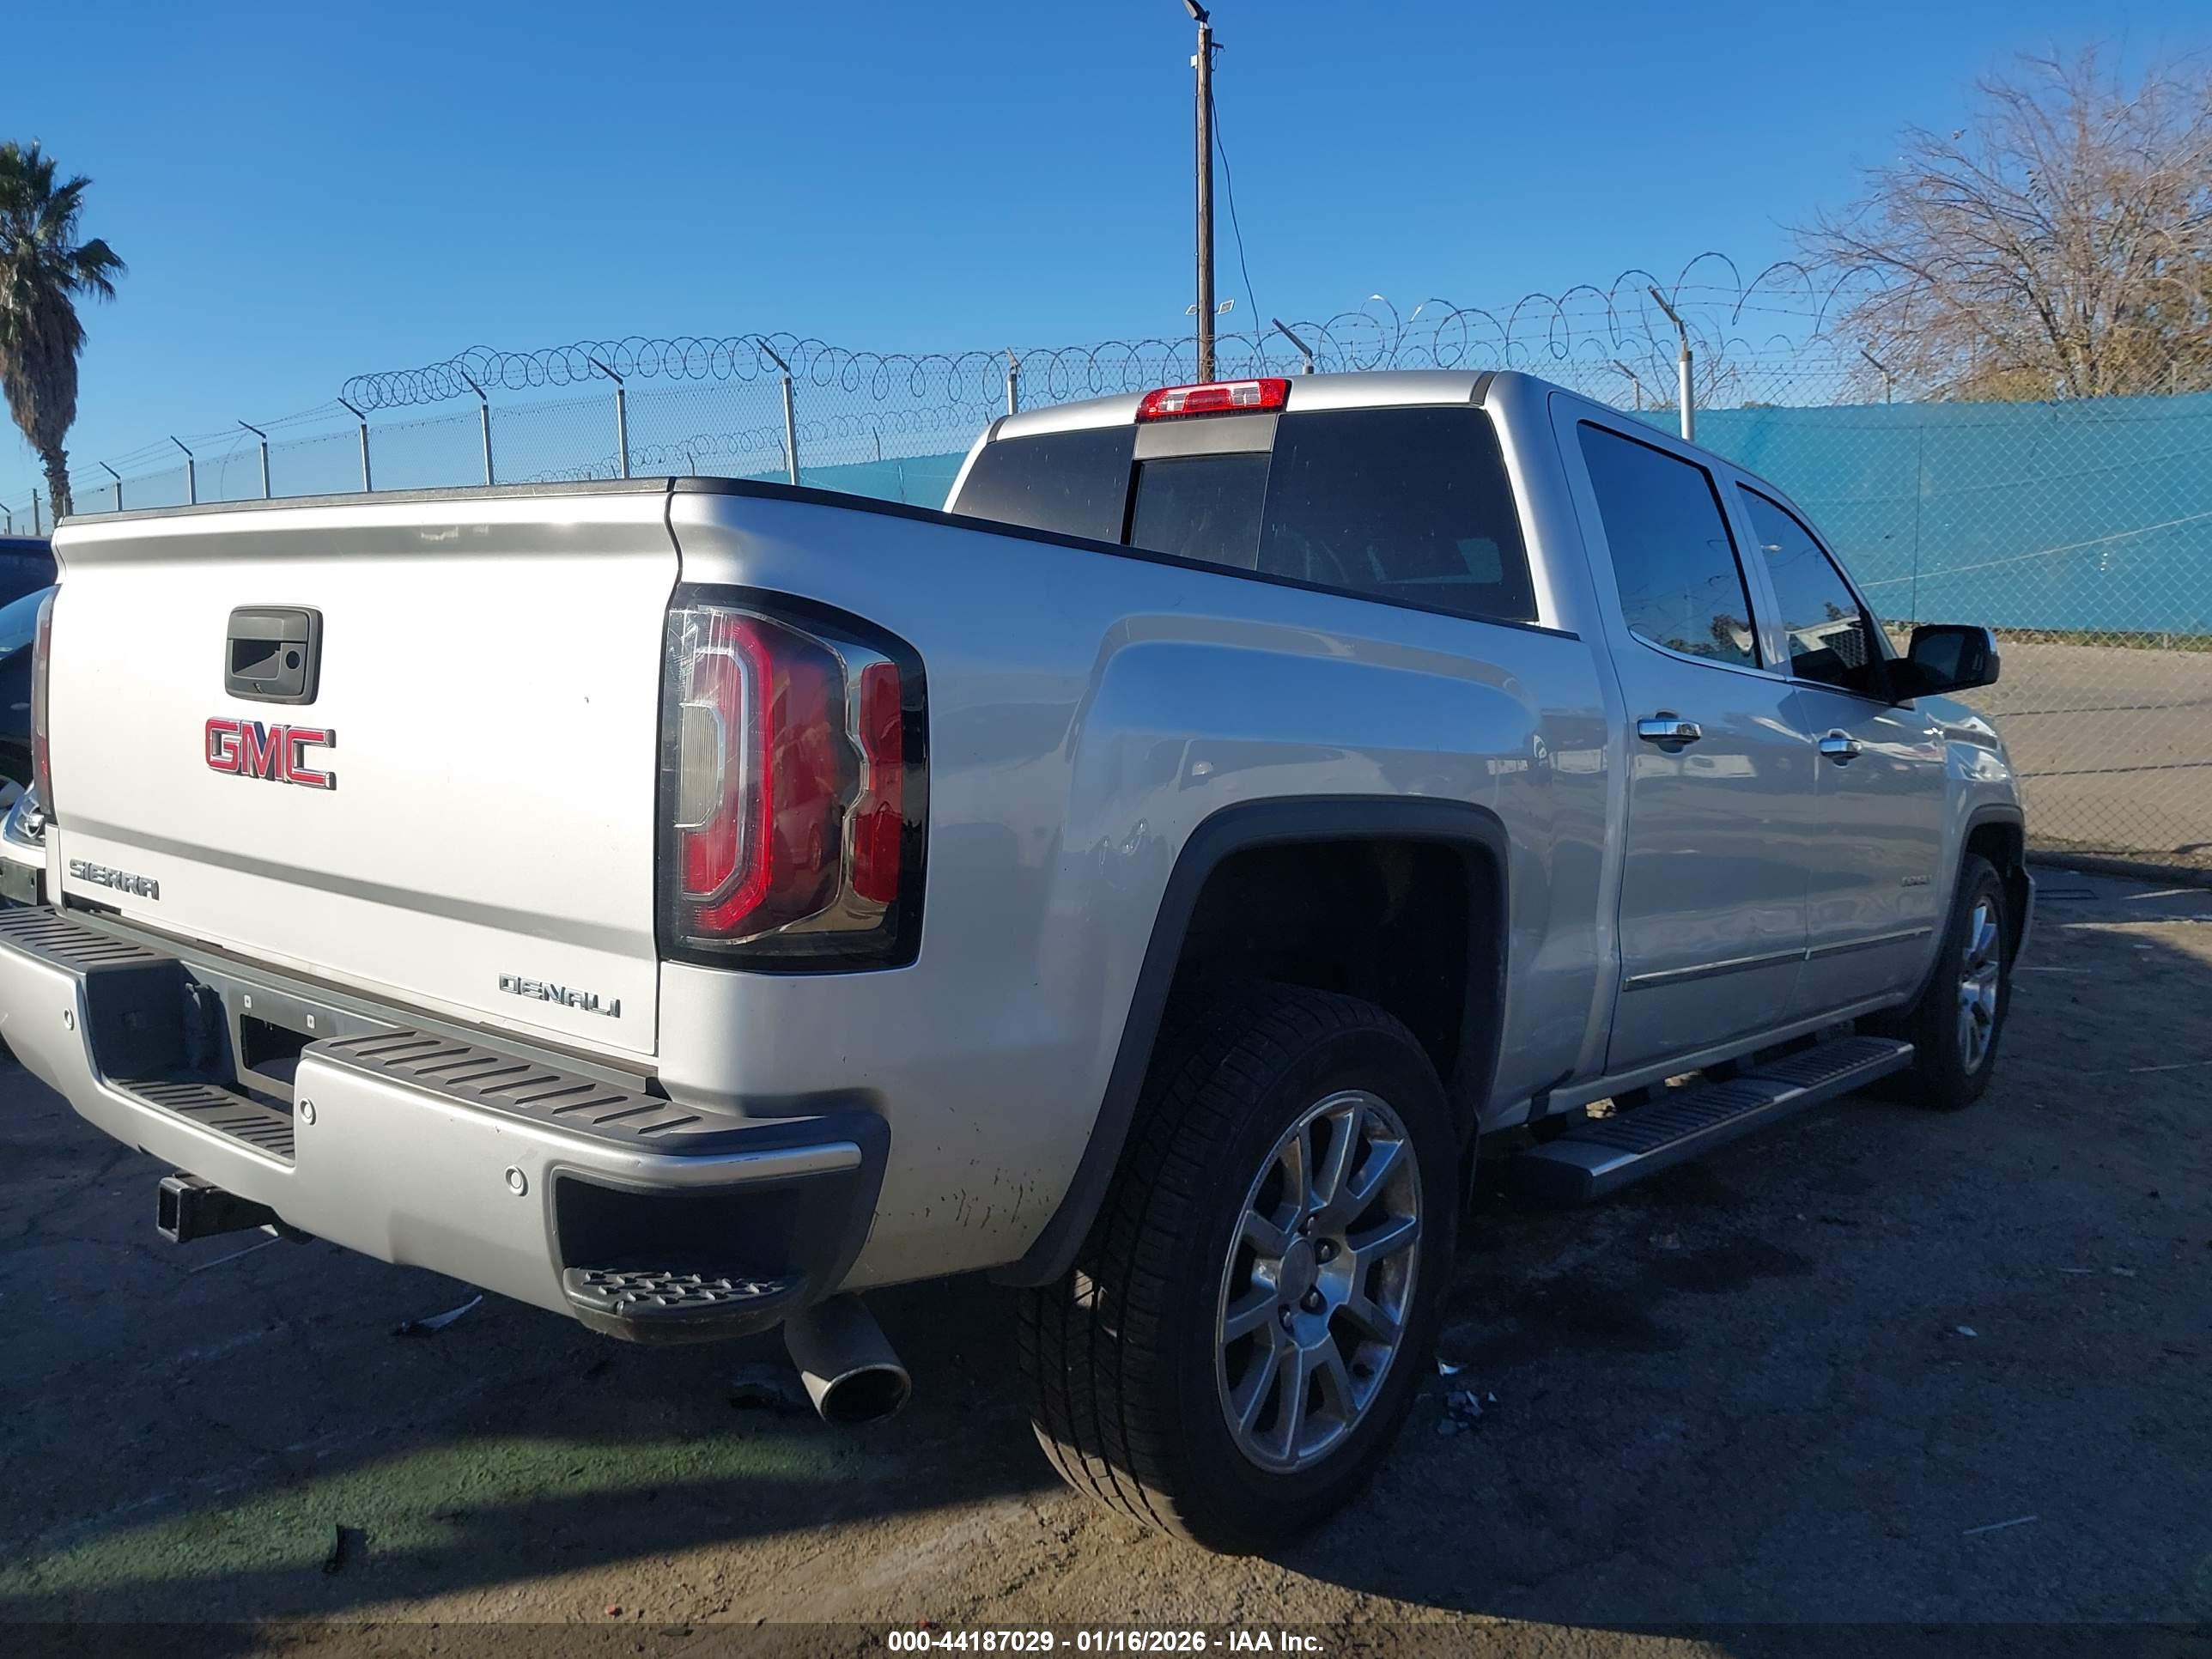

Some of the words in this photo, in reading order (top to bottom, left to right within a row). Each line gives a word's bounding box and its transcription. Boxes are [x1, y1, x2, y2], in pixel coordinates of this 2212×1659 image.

[205, 716, 337, 791] GMC
[70, 858, 160, 901] SIERRA
[499, 973, 621, 1018] DENALI
